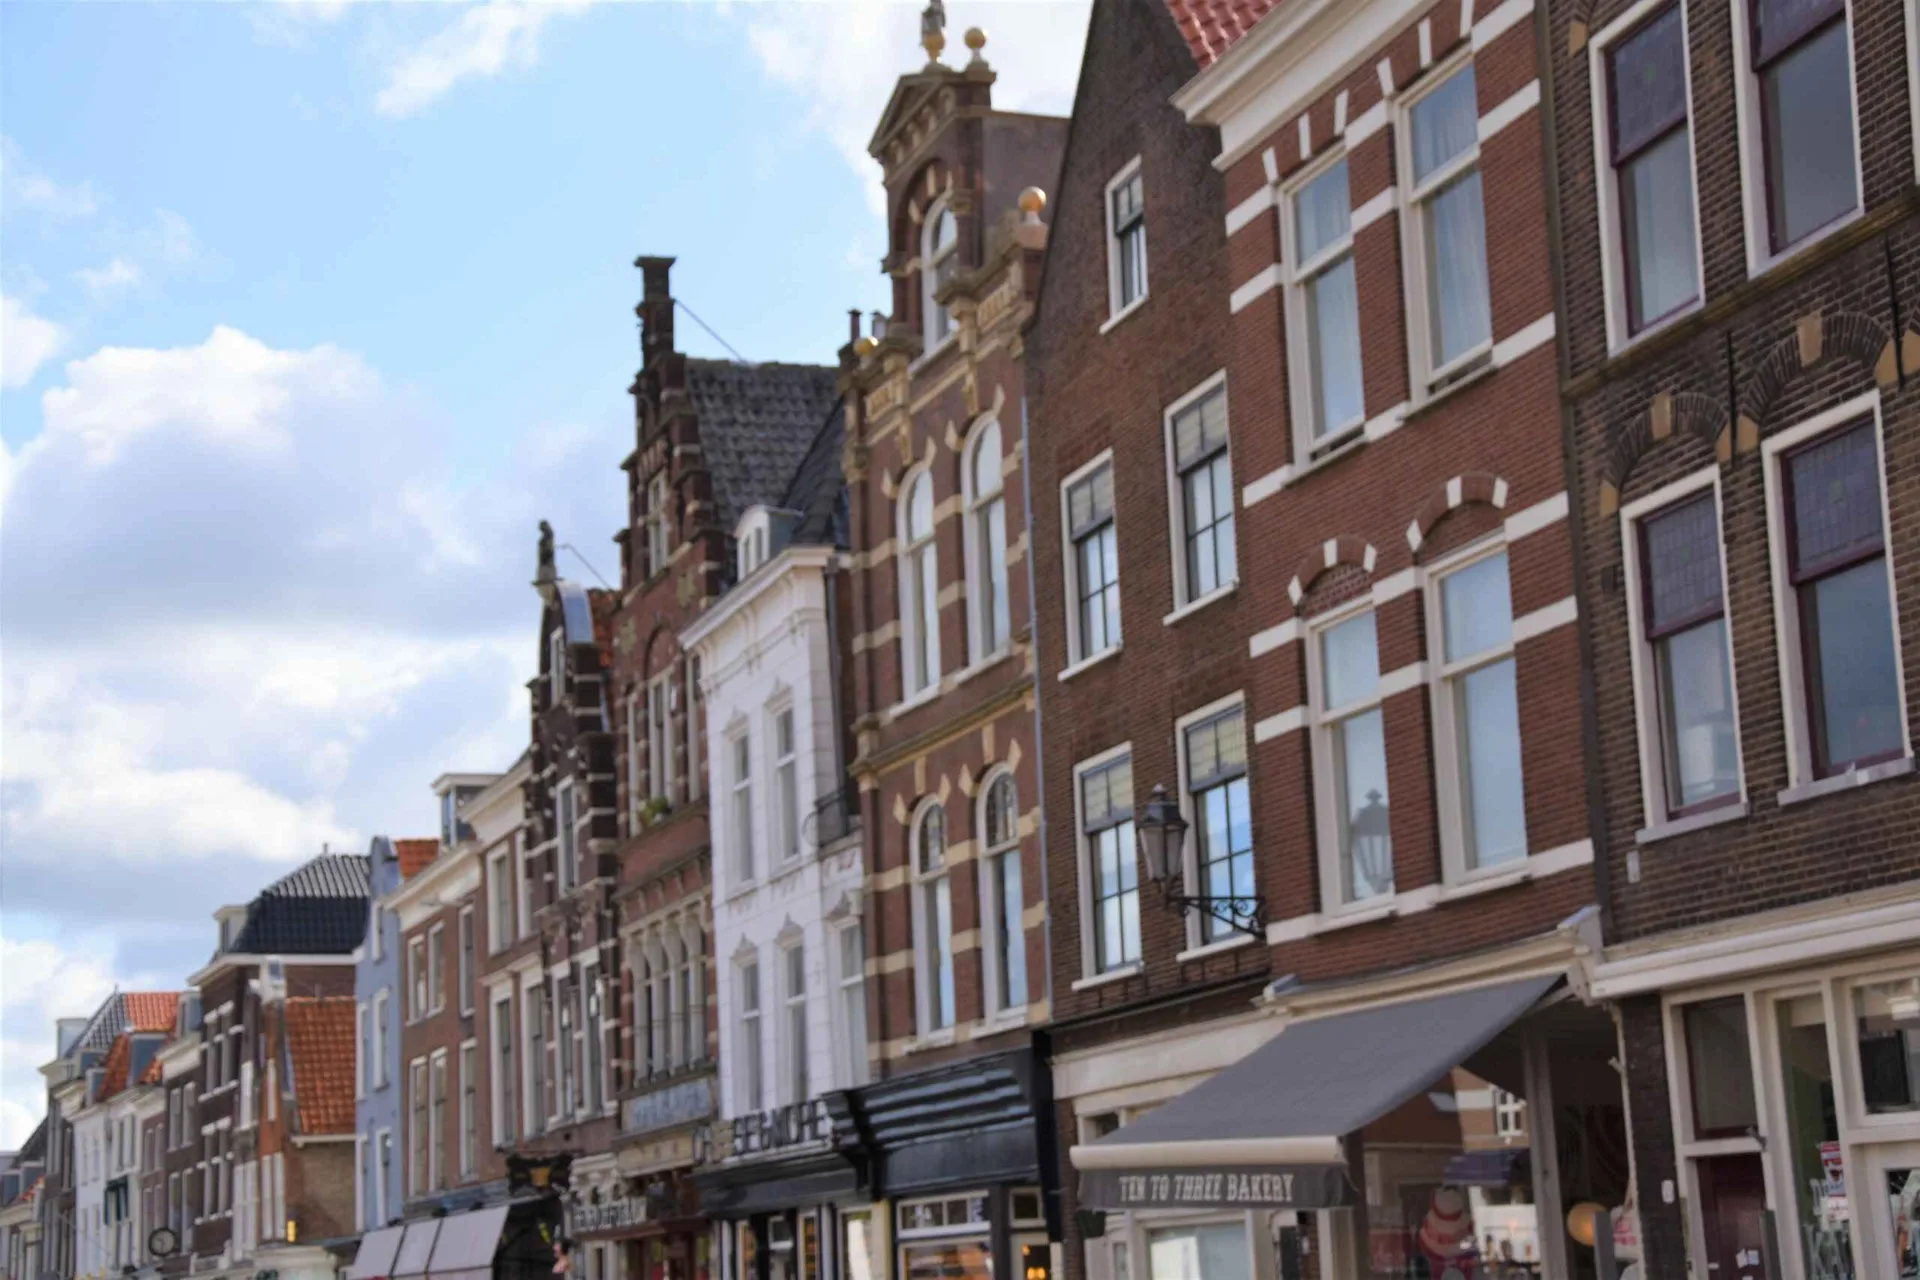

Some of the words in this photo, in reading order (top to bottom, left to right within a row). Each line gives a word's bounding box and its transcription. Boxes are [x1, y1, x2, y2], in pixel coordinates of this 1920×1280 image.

[1119, 1175, 1146, 1202] TEN
[1150, 1174, 1169, 1201] TO
[1174, 1174, 1223, 1201] THREE
[1227, 1173, 1294, 1201] BAKERY
